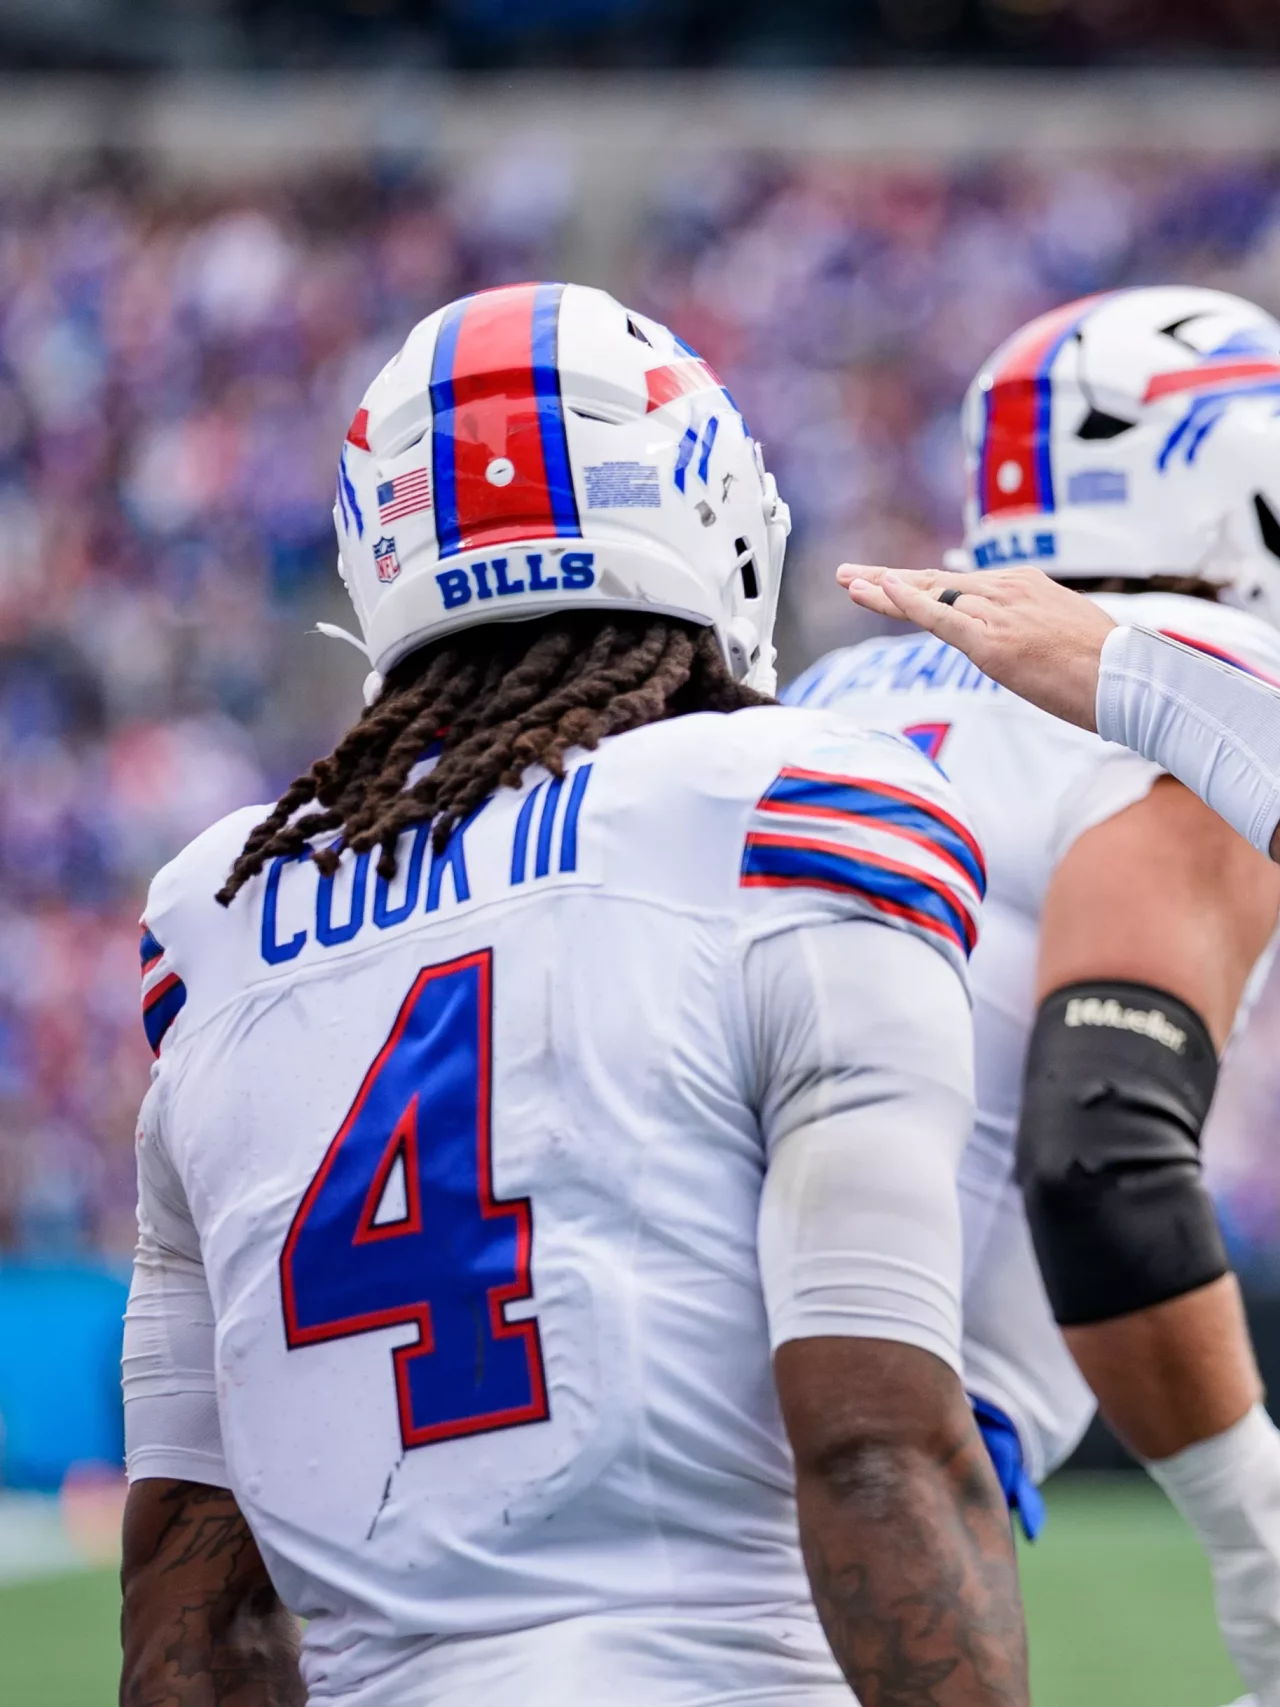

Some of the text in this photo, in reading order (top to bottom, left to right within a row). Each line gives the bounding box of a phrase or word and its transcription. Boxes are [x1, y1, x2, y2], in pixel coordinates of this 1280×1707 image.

[435, 552, 595, 609] BILLS
[260, 797, 495, 967] COOK
[279, 946, 551, 1451] 4
